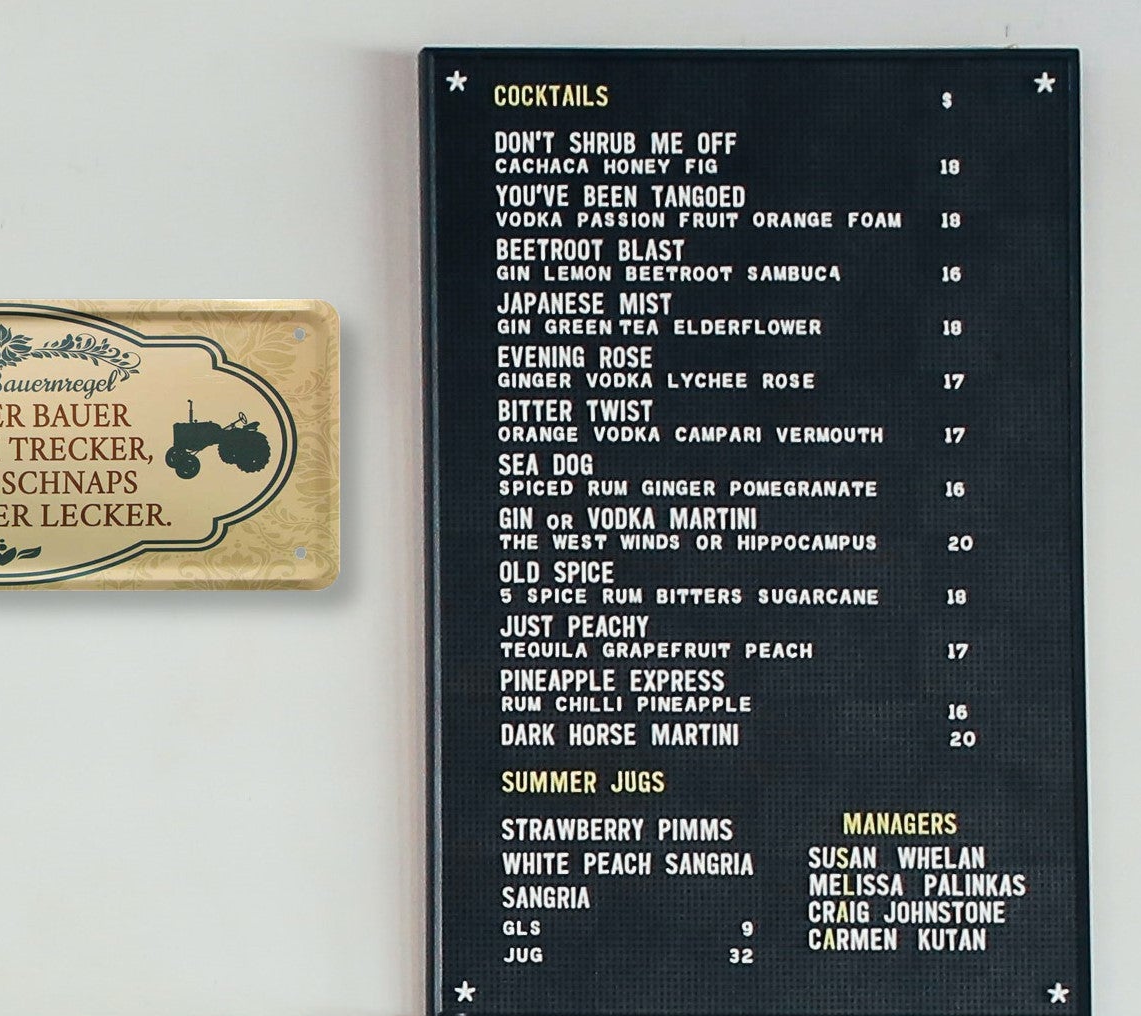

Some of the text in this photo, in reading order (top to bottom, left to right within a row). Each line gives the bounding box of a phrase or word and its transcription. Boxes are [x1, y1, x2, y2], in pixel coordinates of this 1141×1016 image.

[494, 84, 609, 107] COCKTAILS
[494, 130, 737, 155] DON'T SHRUB ME OFF
[495, 157, 960, 176] CACHACA HONEY FIG 18
[495, 183, 746, 209] YOU'VE BEEN TANGOED
[495, 211, 961, 229] VODKA PASSION FRUIT ORANGE FOAM 18
[496, 238, 685, 262] BEETROOT BLAST
[496, 291, 672, 316] JAPANESE MIST
[497, 318, 962, 336] GIN GREEN TEA ELDERFLOWER 18
[497, 345, 653, 370] EVENING ROSE
[33, 404, 131, 428] BAUER
[498, 399, 653, 423] BITTER TWIST
[497, 425, 966, 444] ORANGE VODKA CAMPARI VERMOUTH 17
[8, 437, 155, 465] TRECKER,
[498, 453, 594, 476] SEA DOG
[0, 470, 139, 496] SCHNAPS
[499, 479, 965, 498] SPICED RUM GINGER POMEGRANATE 16
[40, 504, 172, 529] LECKER.
[499, 506, 757, 531] GIN OR VODKA MARTINI
[499, 533, 974, 552] THE WEST WINDS OR HIPPOCAMPUS 20
[499, 560, 614, 584] OLD SPICE
[499, 587, 967, 606] 5 SPICE RUM BITTERS SUGARCANE 18
[499, 614, 649, 639] JUST PEACHY
[500, 641, 969, 660] TEQUILA GRAPEFRUIT PEACH 17
[500, 668, 725, 693] PINEAPPLE EXPRESS
[501, 695, 968, 721] RUM CHILLI PINEAPPLE 16
[501, 722, 977, 748] DARK HORSE MARTINI 20
[501, 770, 665, 794] SUMMER JUGS
[501, 817, 734, 842] STRAWBERRY PIMMS
[843, 812, 958, 836] MANAGERS
[502, 851, 754, 876] WHITE PEACH SANGRIA
[808, 845, 985, 870] SUSAN WHELAN
[502, 885, 591, 910] SANGRIA
[809, 873, 1027, 898] MELISSA PALINKAS
[808, 900, 1006, 924] CRAIG JOHNSTONE
[502, 920, 754, 937] GLS 9
[808, 927, 986, 952] CARMEN KUTAN
[503, 946, 754, 964] JUG 32
